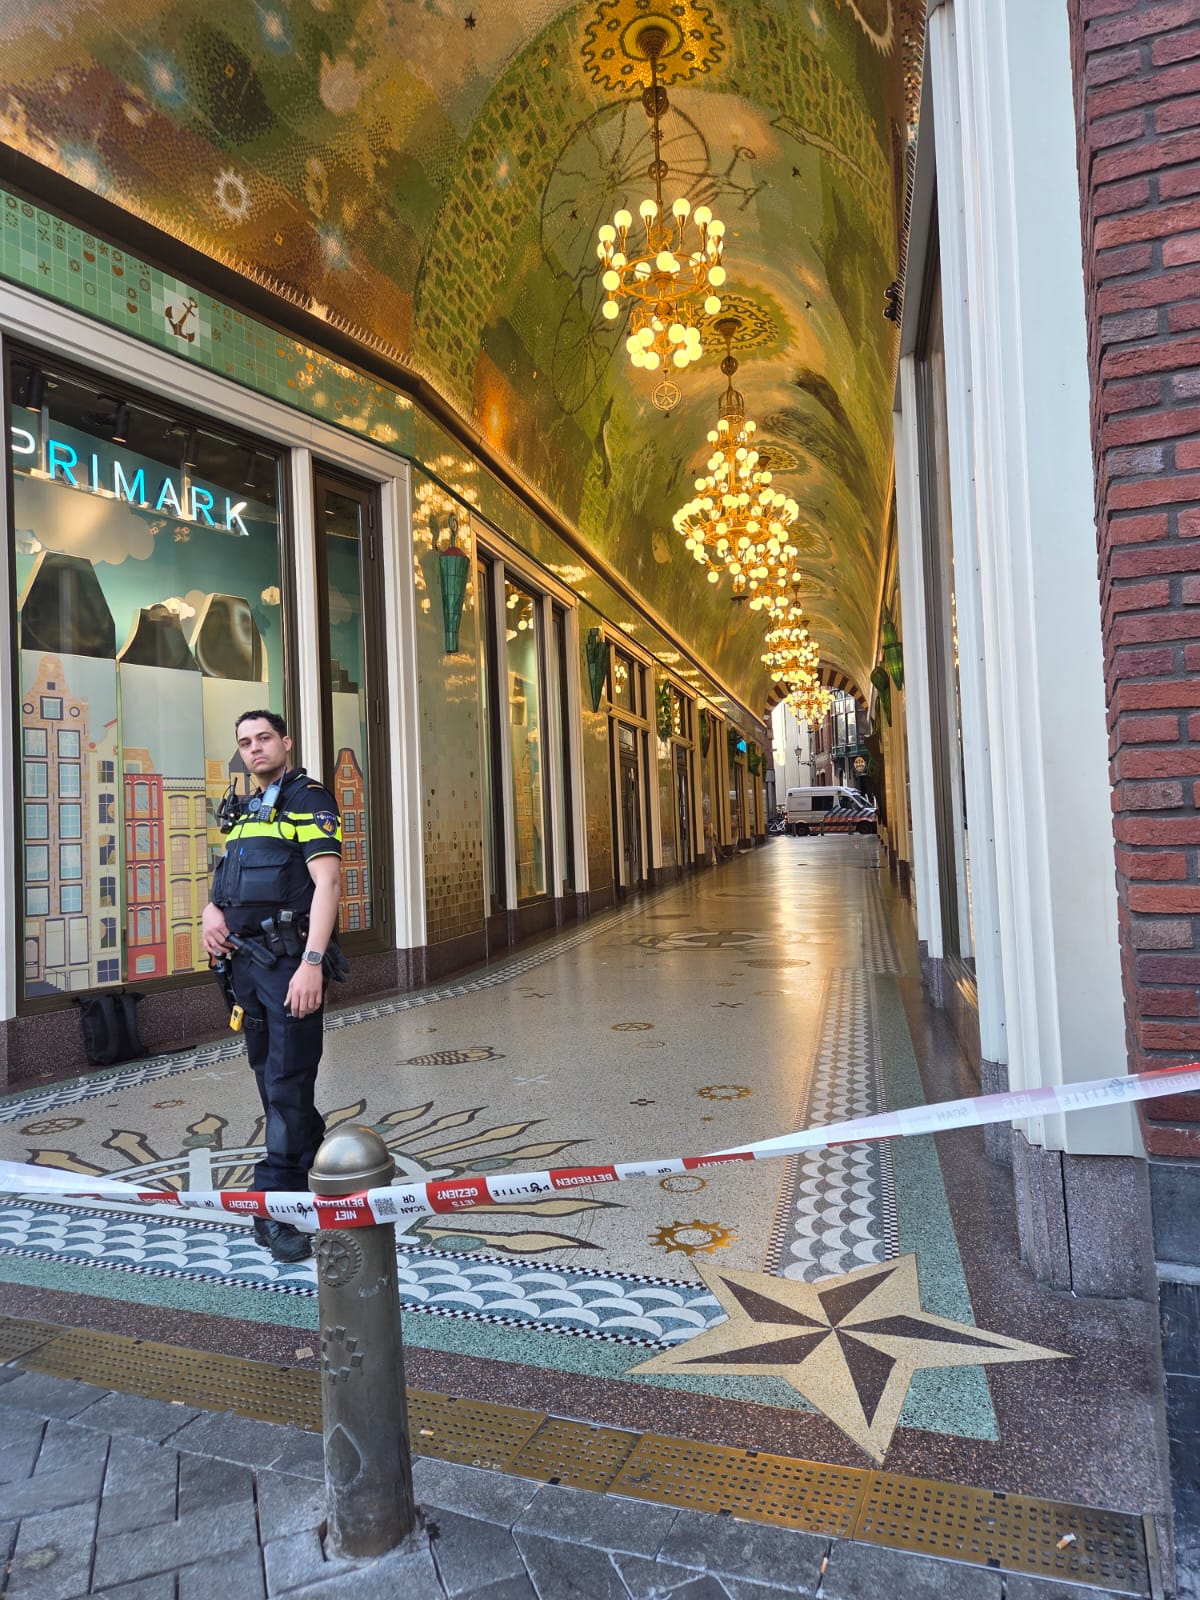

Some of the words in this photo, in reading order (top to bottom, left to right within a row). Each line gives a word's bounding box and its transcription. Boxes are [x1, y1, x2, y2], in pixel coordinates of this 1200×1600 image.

[555, 1172, 614, 1187] BETREDEN
[436, 1187, 480, 1200] GEZIEN?
[229, 1200, 259, 1209] GEZIEN?
[402, 1194, 416, 1205] QR
[335, 1210, 358, 1221] NIET
[401, 1205, 427, 1215] SCAN
